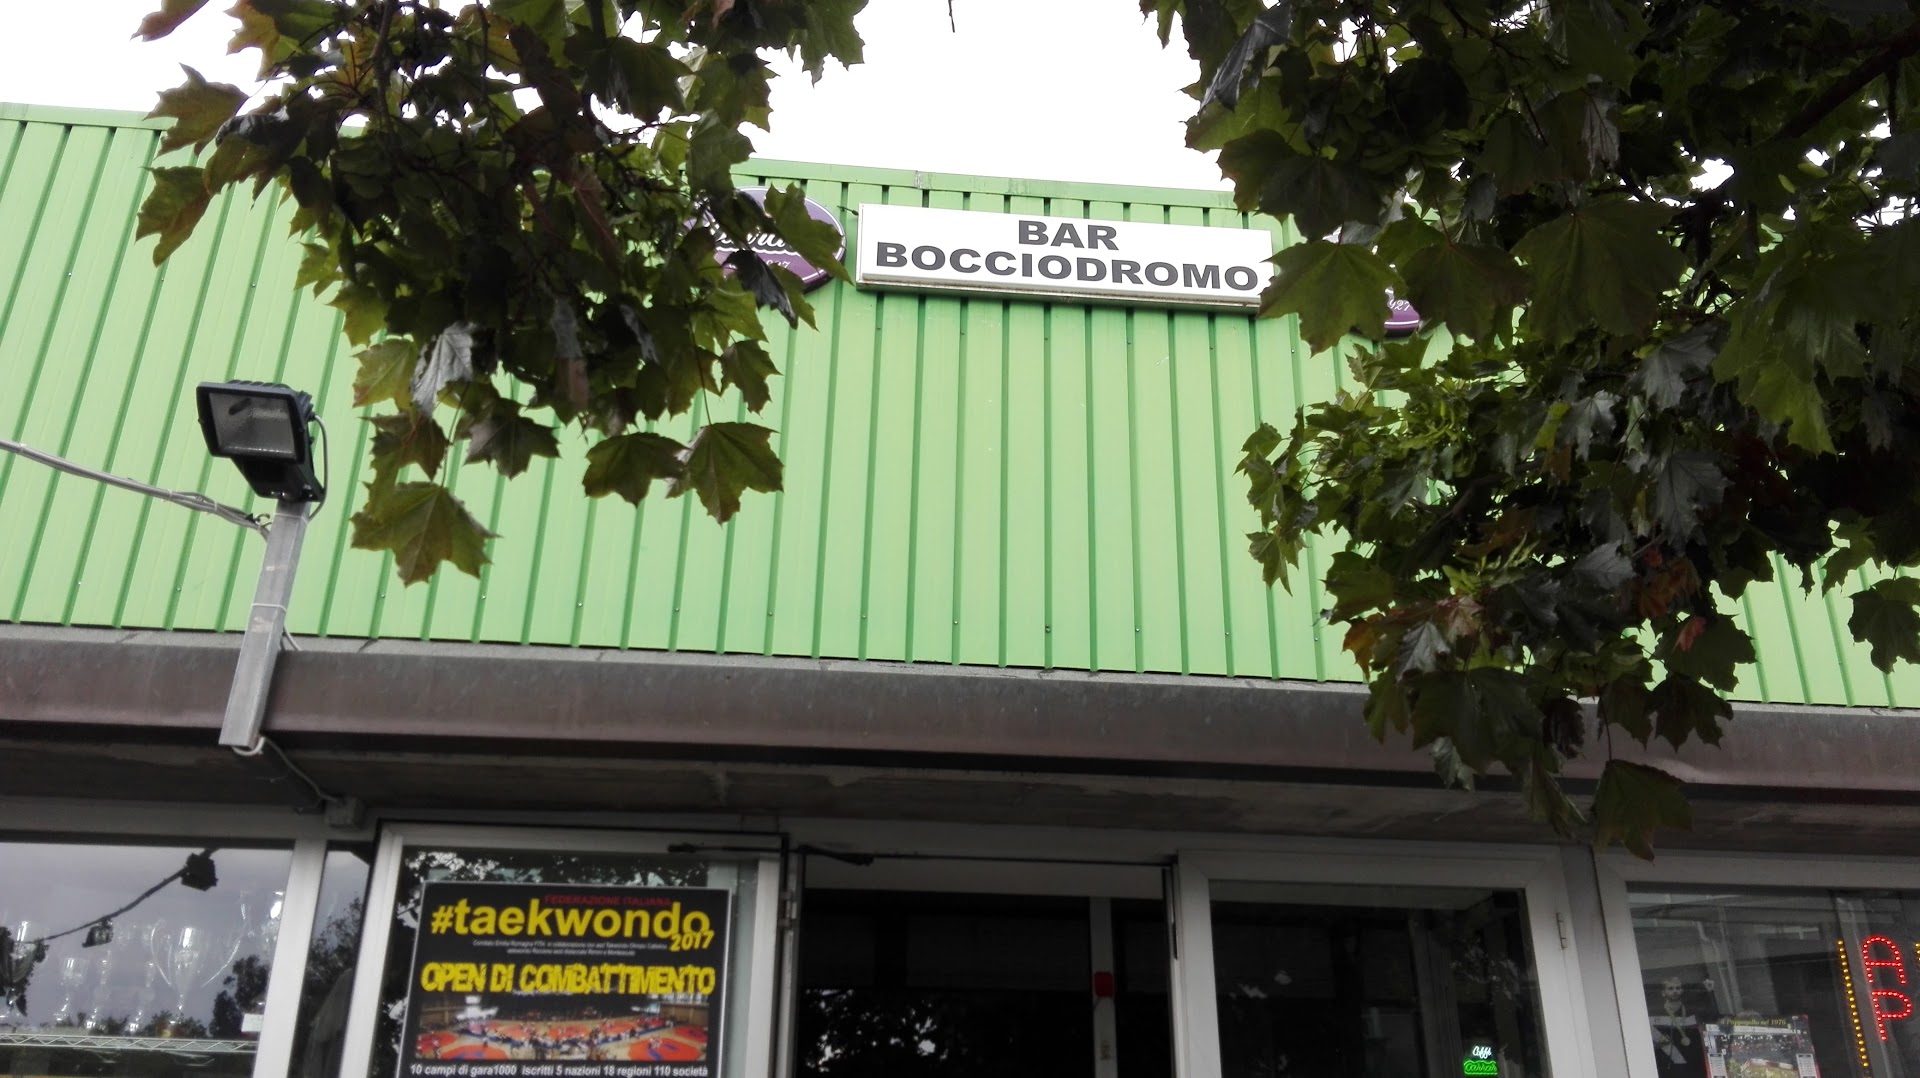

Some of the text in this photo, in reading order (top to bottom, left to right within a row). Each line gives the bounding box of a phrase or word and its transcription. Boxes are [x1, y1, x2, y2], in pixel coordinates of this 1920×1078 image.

[1018, 219, 1119, 251] BAR
[876, 241, 1258, 291] BOCCIODROMO
[431, 899, 711, 937] #taekwondo
[670, 930, 715, 952] 2017
[421, 962, 716, 995] OPEN DI COMBATTIMENTO
[410, 1064, 422, 1075] 10
[424, 1065, 456, 1077] campi
[458, 1064, 468, 1076] di
[521, 1065, 554, 1076] iscritti
[556, 1065, 563, 1076] 5
[564, 1065, 600, 1076] nazioni
[603, 1065, 615, 1076] 18
[617, 1065, 652, 1078] regioni
[654, 1065, 671, 1076] 110
